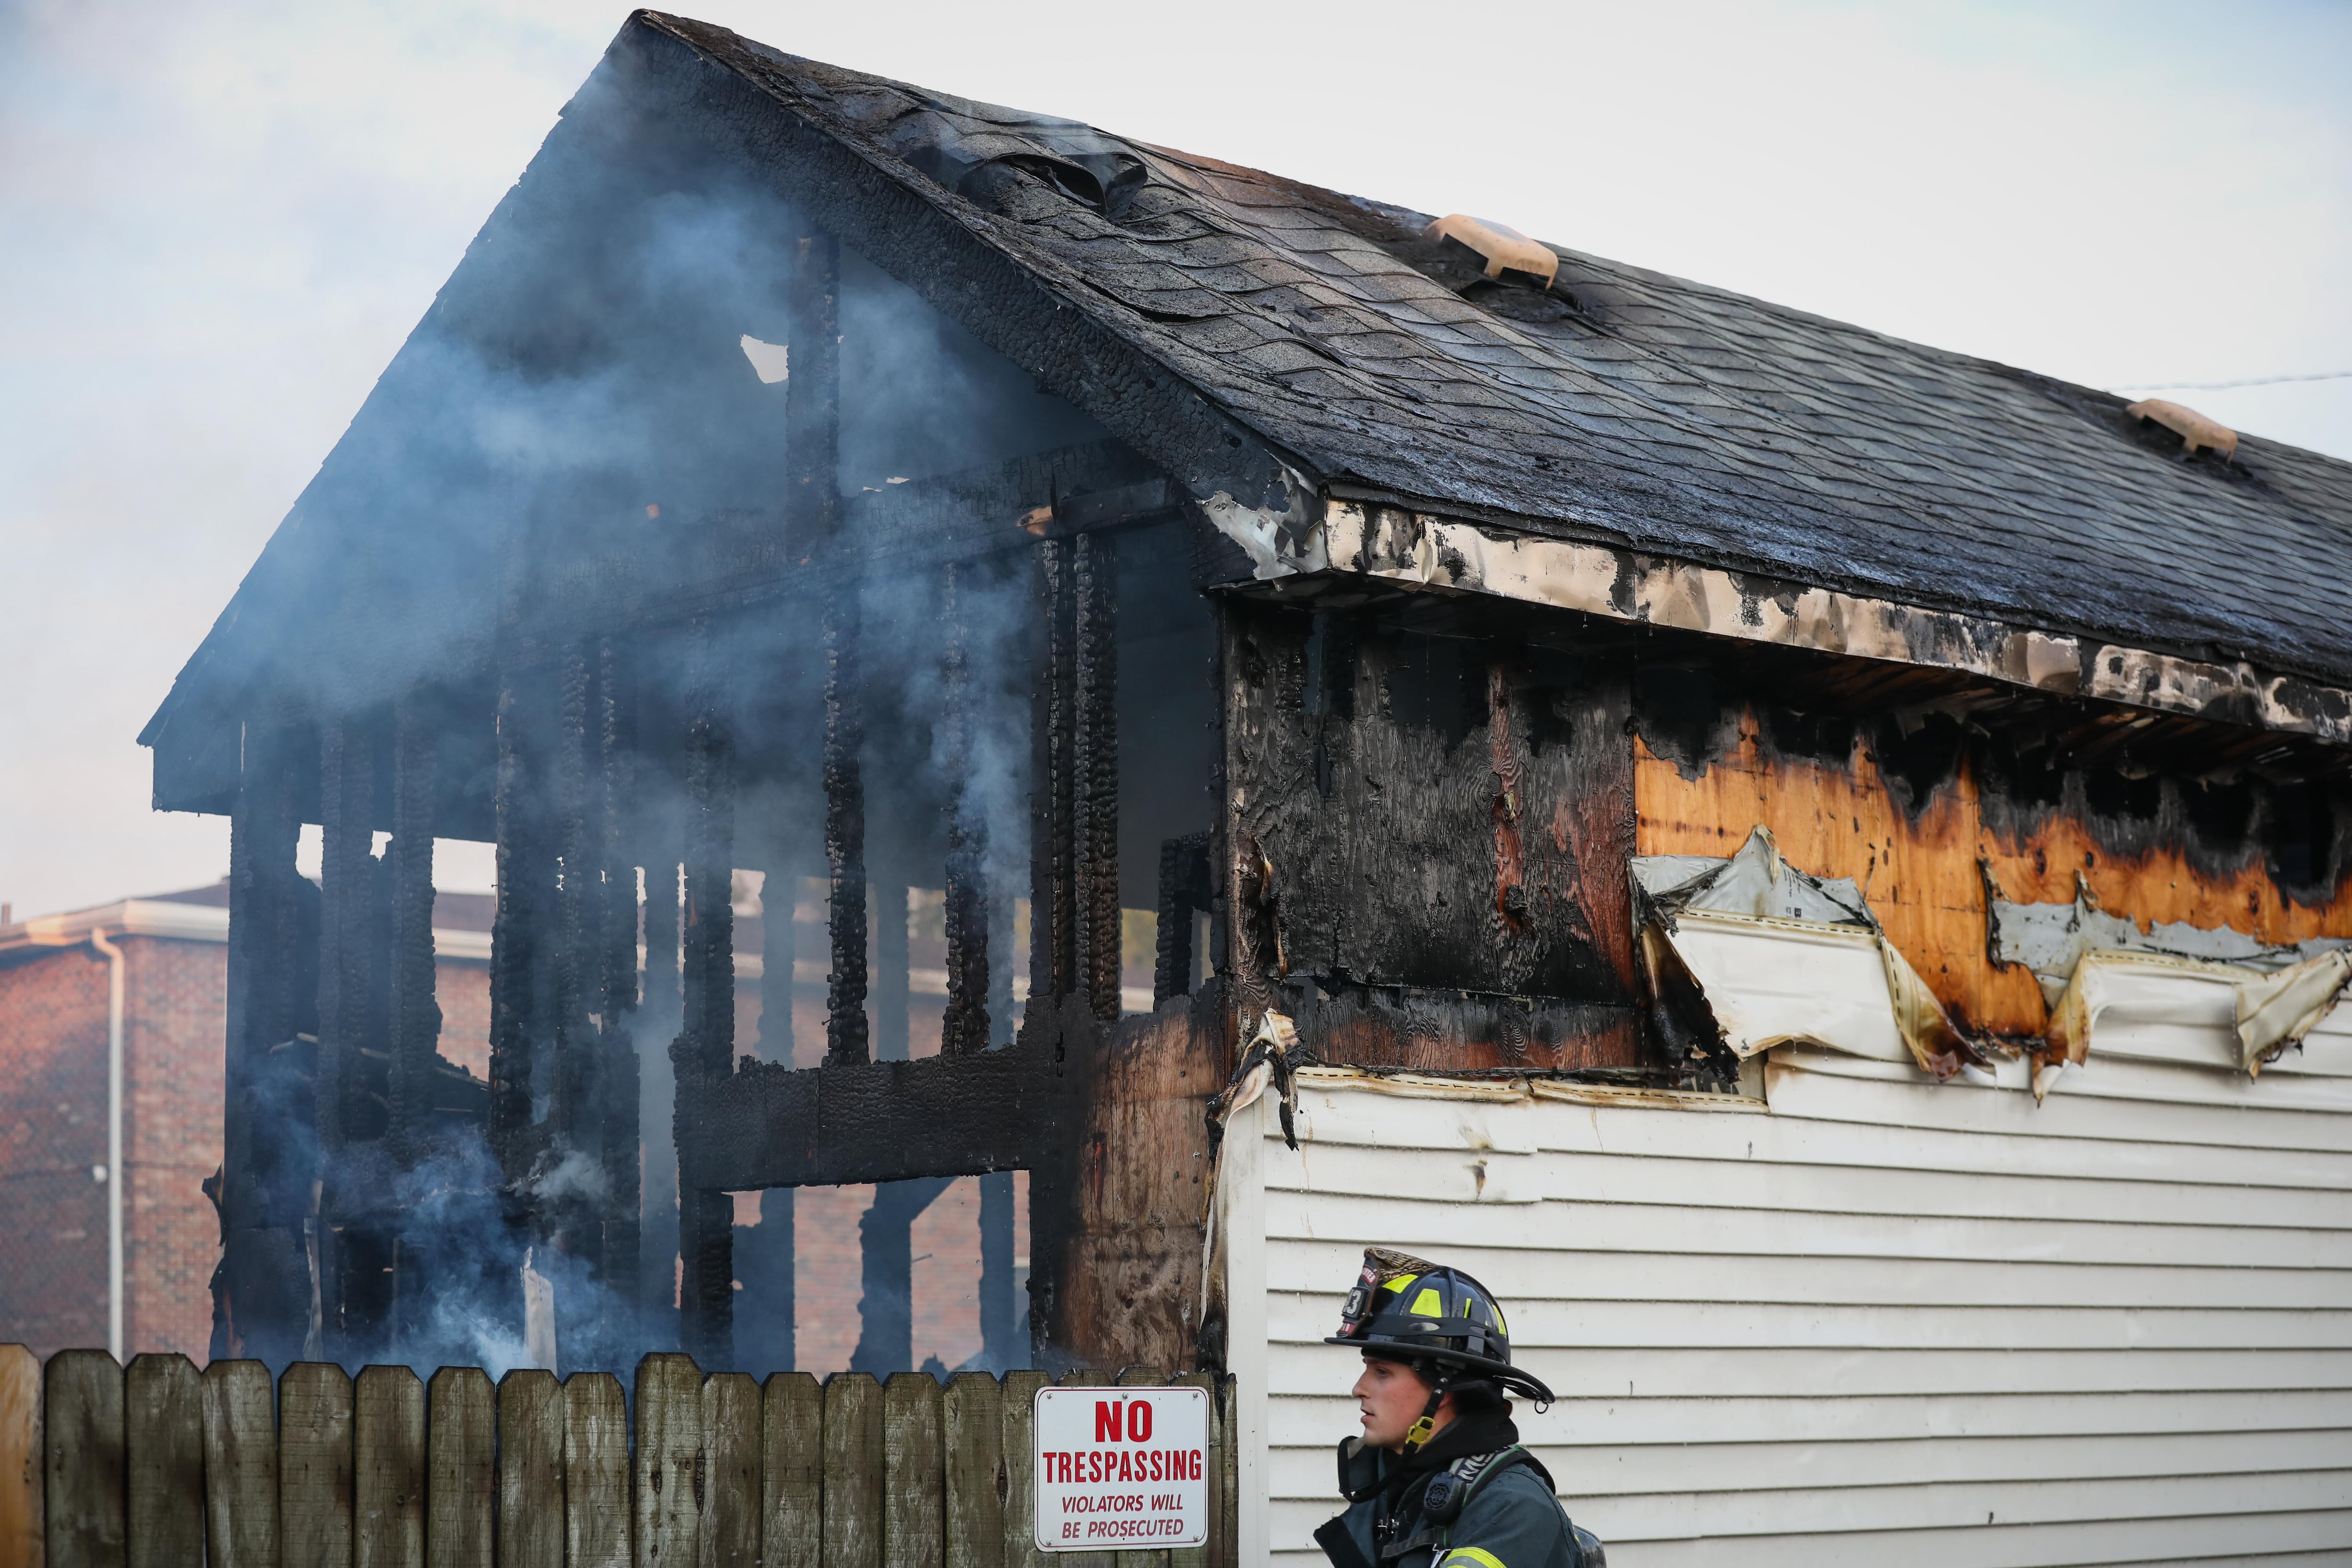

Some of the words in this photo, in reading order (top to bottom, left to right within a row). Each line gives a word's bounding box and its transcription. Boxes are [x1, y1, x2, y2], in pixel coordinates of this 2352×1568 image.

[1095, 1401, 1152, 1442] NO
[1043, 1449, 1201, 1483] TRESPASSING
[1062, 1495, 1144, 1513] VIOLATORS
[1151, 1494, 1184, 1511] WILL
[1062, 1522, 1081, 1539] BE
[1088, 1519, 1184, 1537] PROSECUTED
